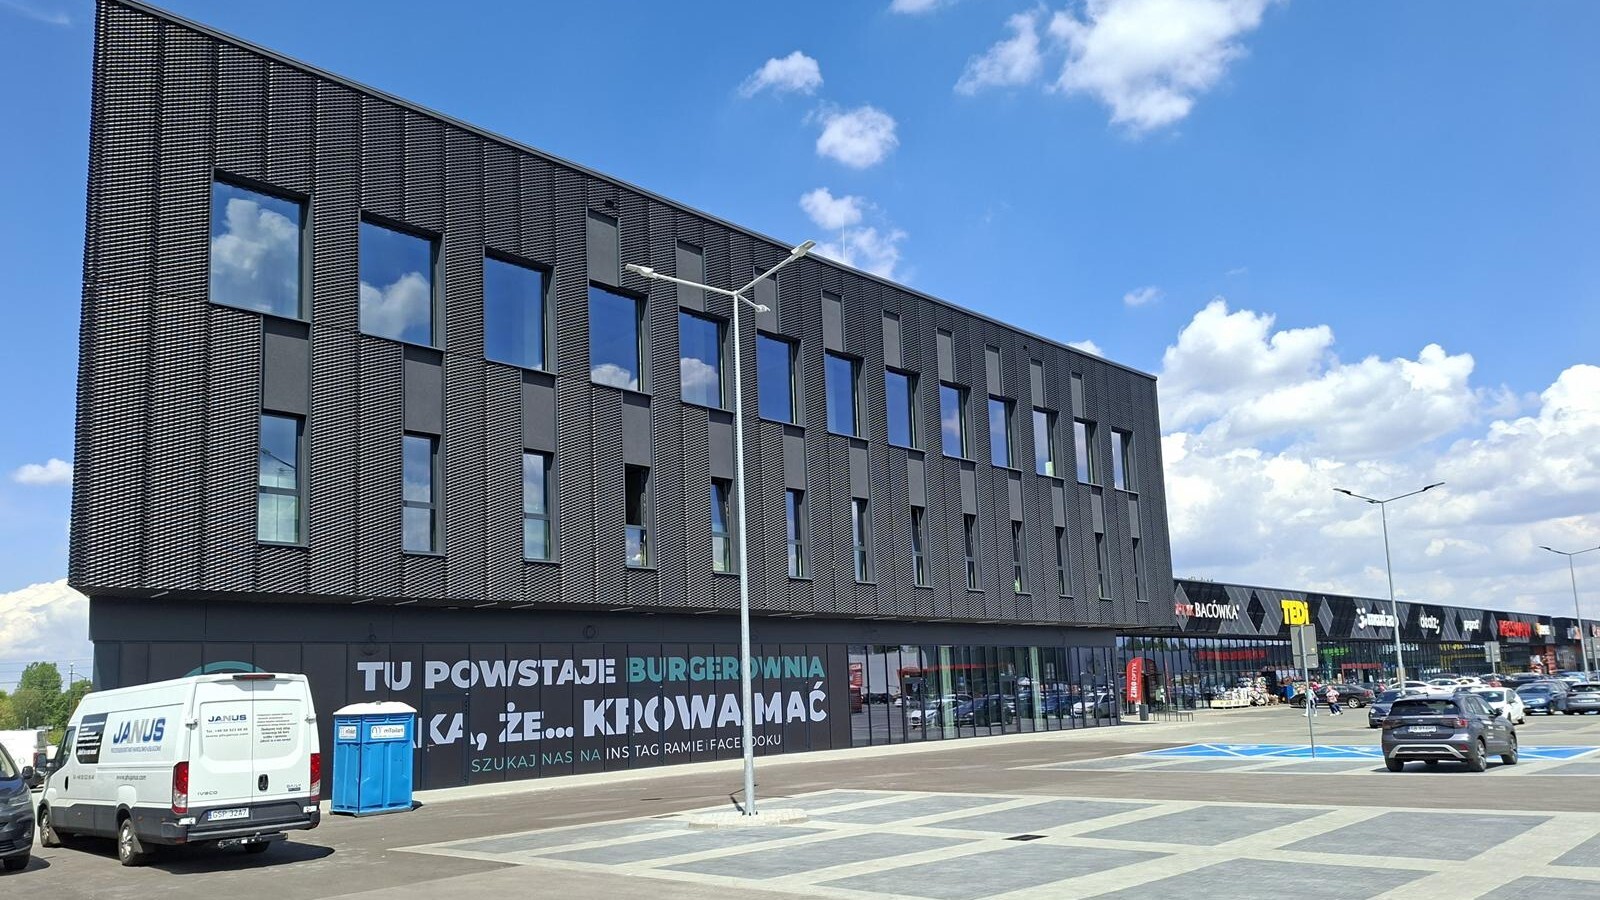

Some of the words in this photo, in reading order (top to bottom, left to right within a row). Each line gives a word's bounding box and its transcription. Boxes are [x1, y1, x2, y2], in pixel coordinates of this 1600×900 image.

[1194, 600, 1239, 620] BACÓWKA
[1281, 600, 1310, 625] TEDi
[357, 661, 412, 691] TU
[425, 659, 616, 690] POWSTAJE
[626, 656, 825, 682] BURGEROWNIA
[207, 714, 247, 722] JANUS
[584, 693, 742, 737] KROWA
[754, 681, 827, 725] MAĆ
[112, 717, 166, 744] JANUS
[471, 754, 536, 772] SZUKAJ
[542, 750, 573, 766] NAS
[580, 749, 601, 762] NA
[710, 734, 781, 751] FACEOOKU
